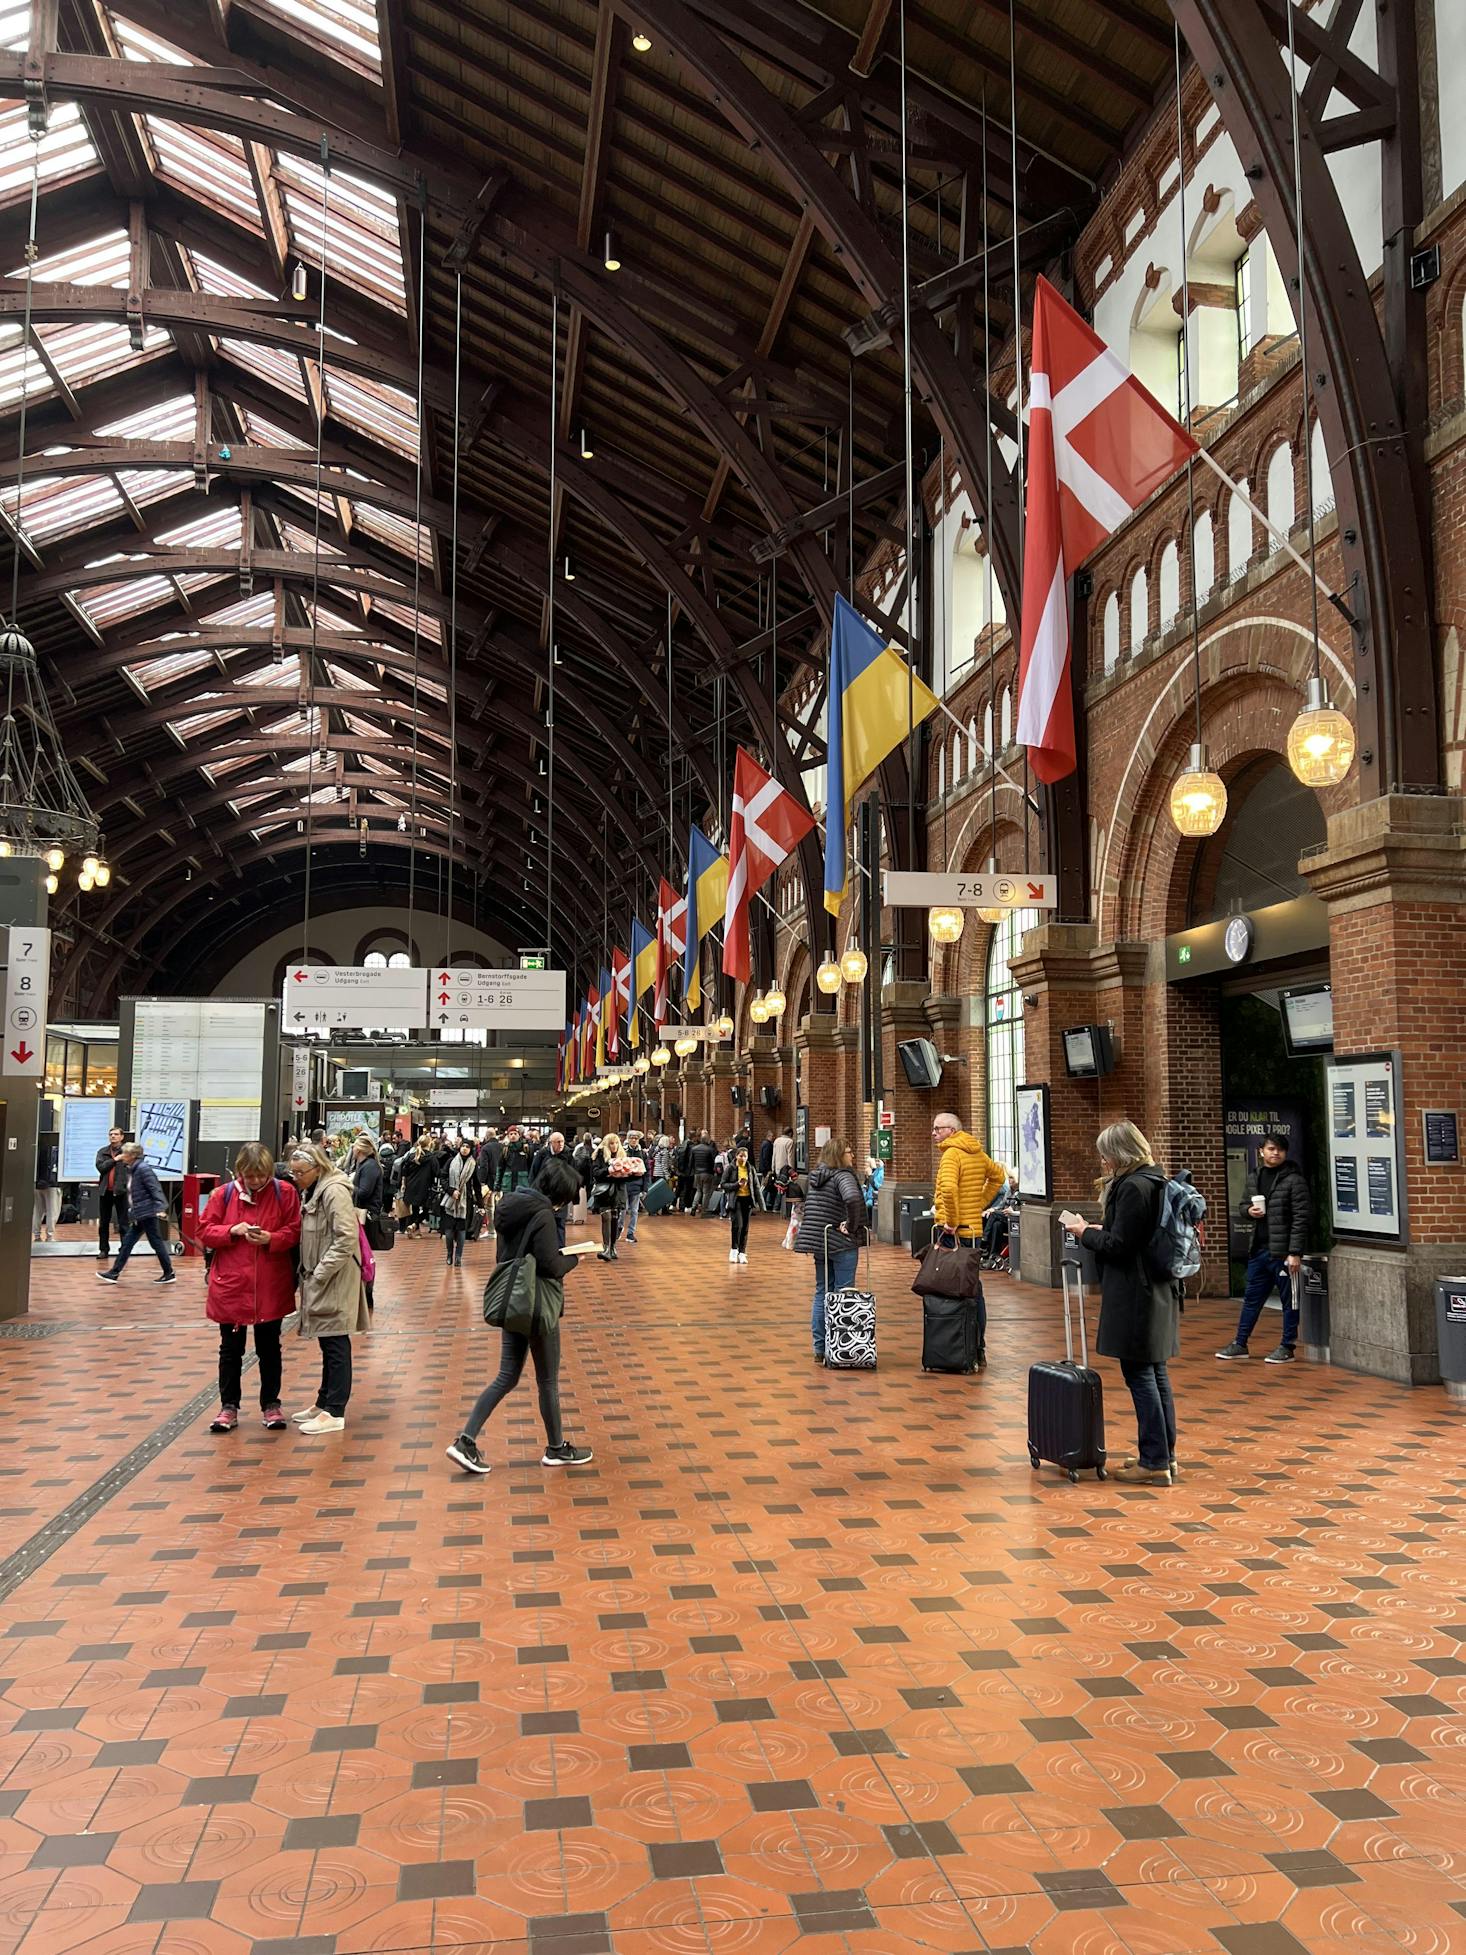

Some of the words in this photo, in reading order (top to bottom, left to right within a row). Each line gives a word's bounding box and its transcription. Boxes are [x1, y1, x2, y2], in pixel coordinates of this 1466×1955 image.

[957, 883, 983, 896] 7-8
[22, 942, 33, 957] 7
[20, 976, 31, 991] 8
[477, 995, 494, 1004] 1-6
[499, 995, 513, 1004] 26
[295, 1068, 306, 1076] 26
[1227, 1111, 1237, 1122] ER
[1238, 1111, 1249, 1122] DU
[1269, 1111, 1280, 1122] TIL
[1246, 1124, 1265, 1135] PIXEL
[1266, 1124, 1272, 1134] 7
[1272, 1124, 1291, 1135] PRO?
